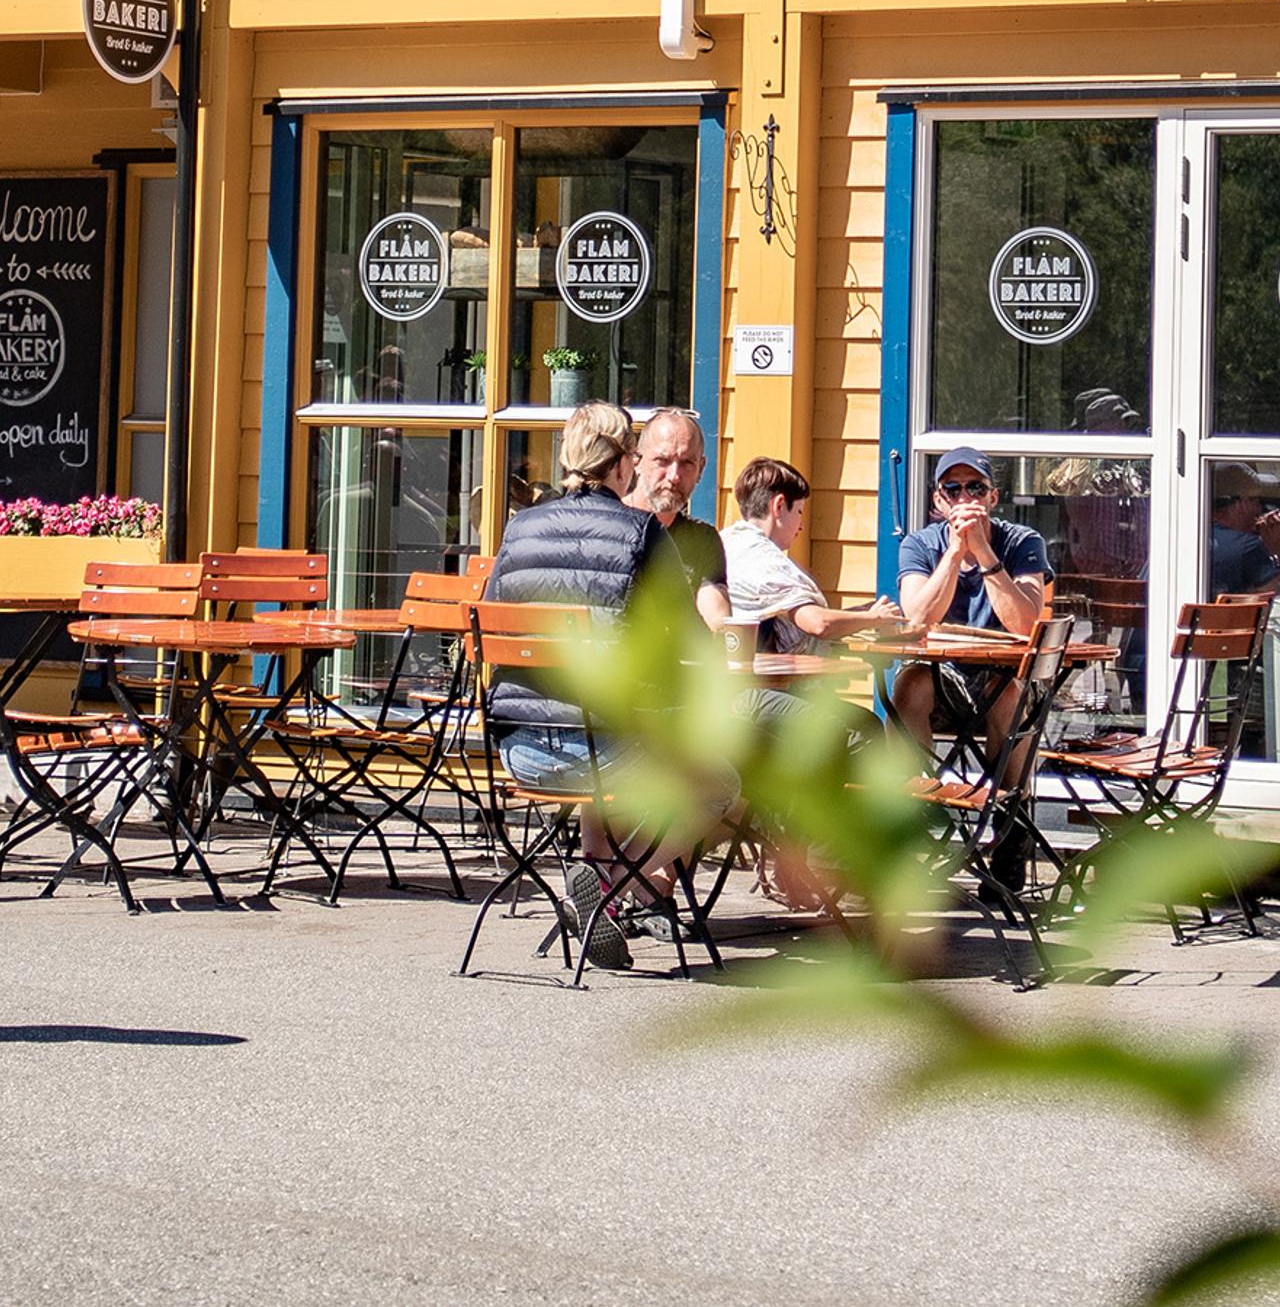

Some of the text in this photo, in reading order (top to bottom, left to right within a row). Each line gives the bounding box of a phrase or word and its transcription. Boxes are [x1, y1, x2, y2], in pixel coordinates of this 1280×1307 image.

[379, 235, 429, 257] FLÅM
[577, 235, 629, 257] FLÅM
[7, 253, 31, 282] to
[369, 263, 438, 282] BAKERI
[567, 264, 638, 283] BAKERI
[1012, 252, 1070, 275] FLÅM
[1000, 283, 1081, 301] BAKERI
[11, 366, 23, 382] &
[24, 367, 48, 381] cake
[48, 412, 89, 467] daily
